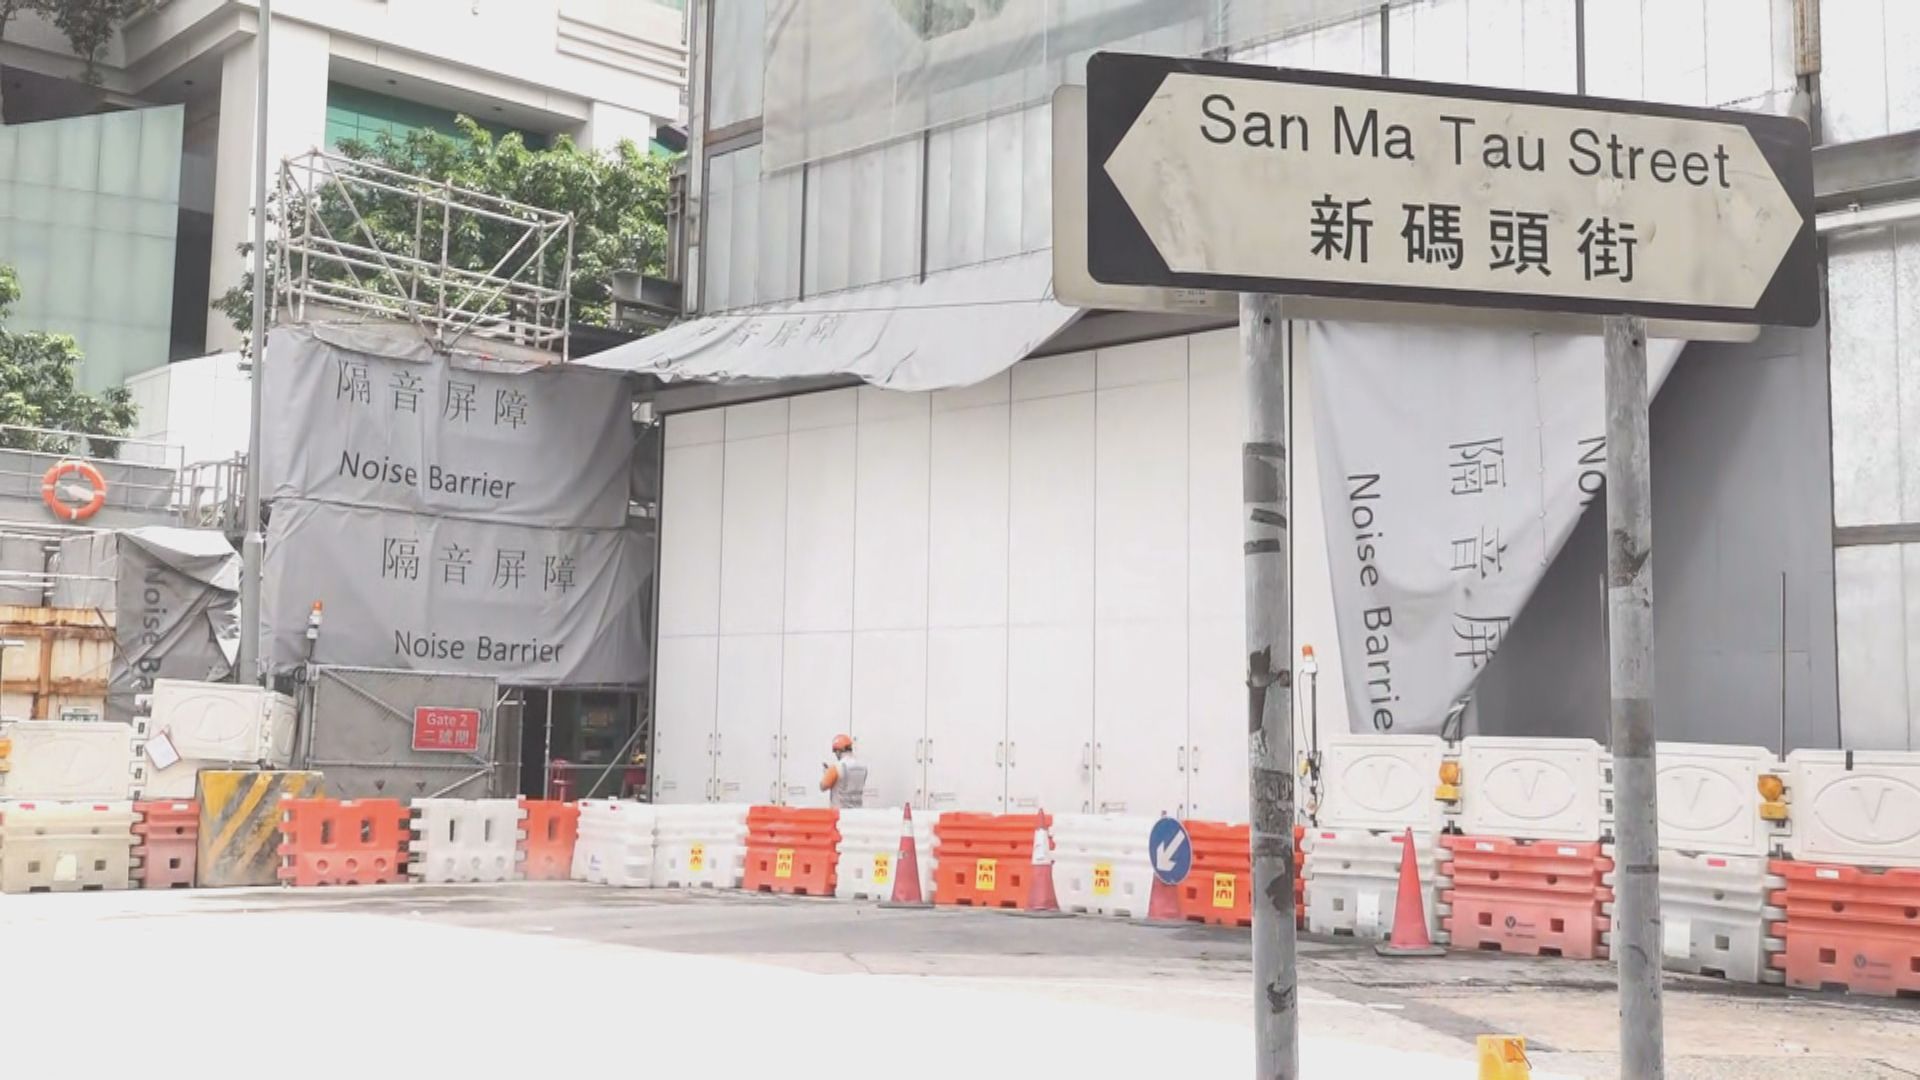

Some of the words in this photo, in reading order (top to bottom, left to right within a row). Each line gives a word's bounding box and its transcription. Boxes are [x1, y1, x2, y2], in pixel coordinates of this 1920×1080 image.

[1200, 94, 1309, 151] San
[1334, 106, 1415, 160] Ma
[1440, 116, 1545, 171] Tau
[1569, 128, 1731, 188] Street
[1310, 194, 1638, 283] 新碼頭街
[337, 359, 528, 429] 隔音屏障
[339, 450, 417, 486] Noise
[429, 465, 516, 499] Barrier
[1348, 473, 1384, 588] Noise
[382, 536, 577, 593] 隔音屏障
[395, 629, 465, 660] Noise
[477, 635, 564, 663] Barrier
[426, 712, 457, 727] Gate
[460, 713, 468, 727] 2
